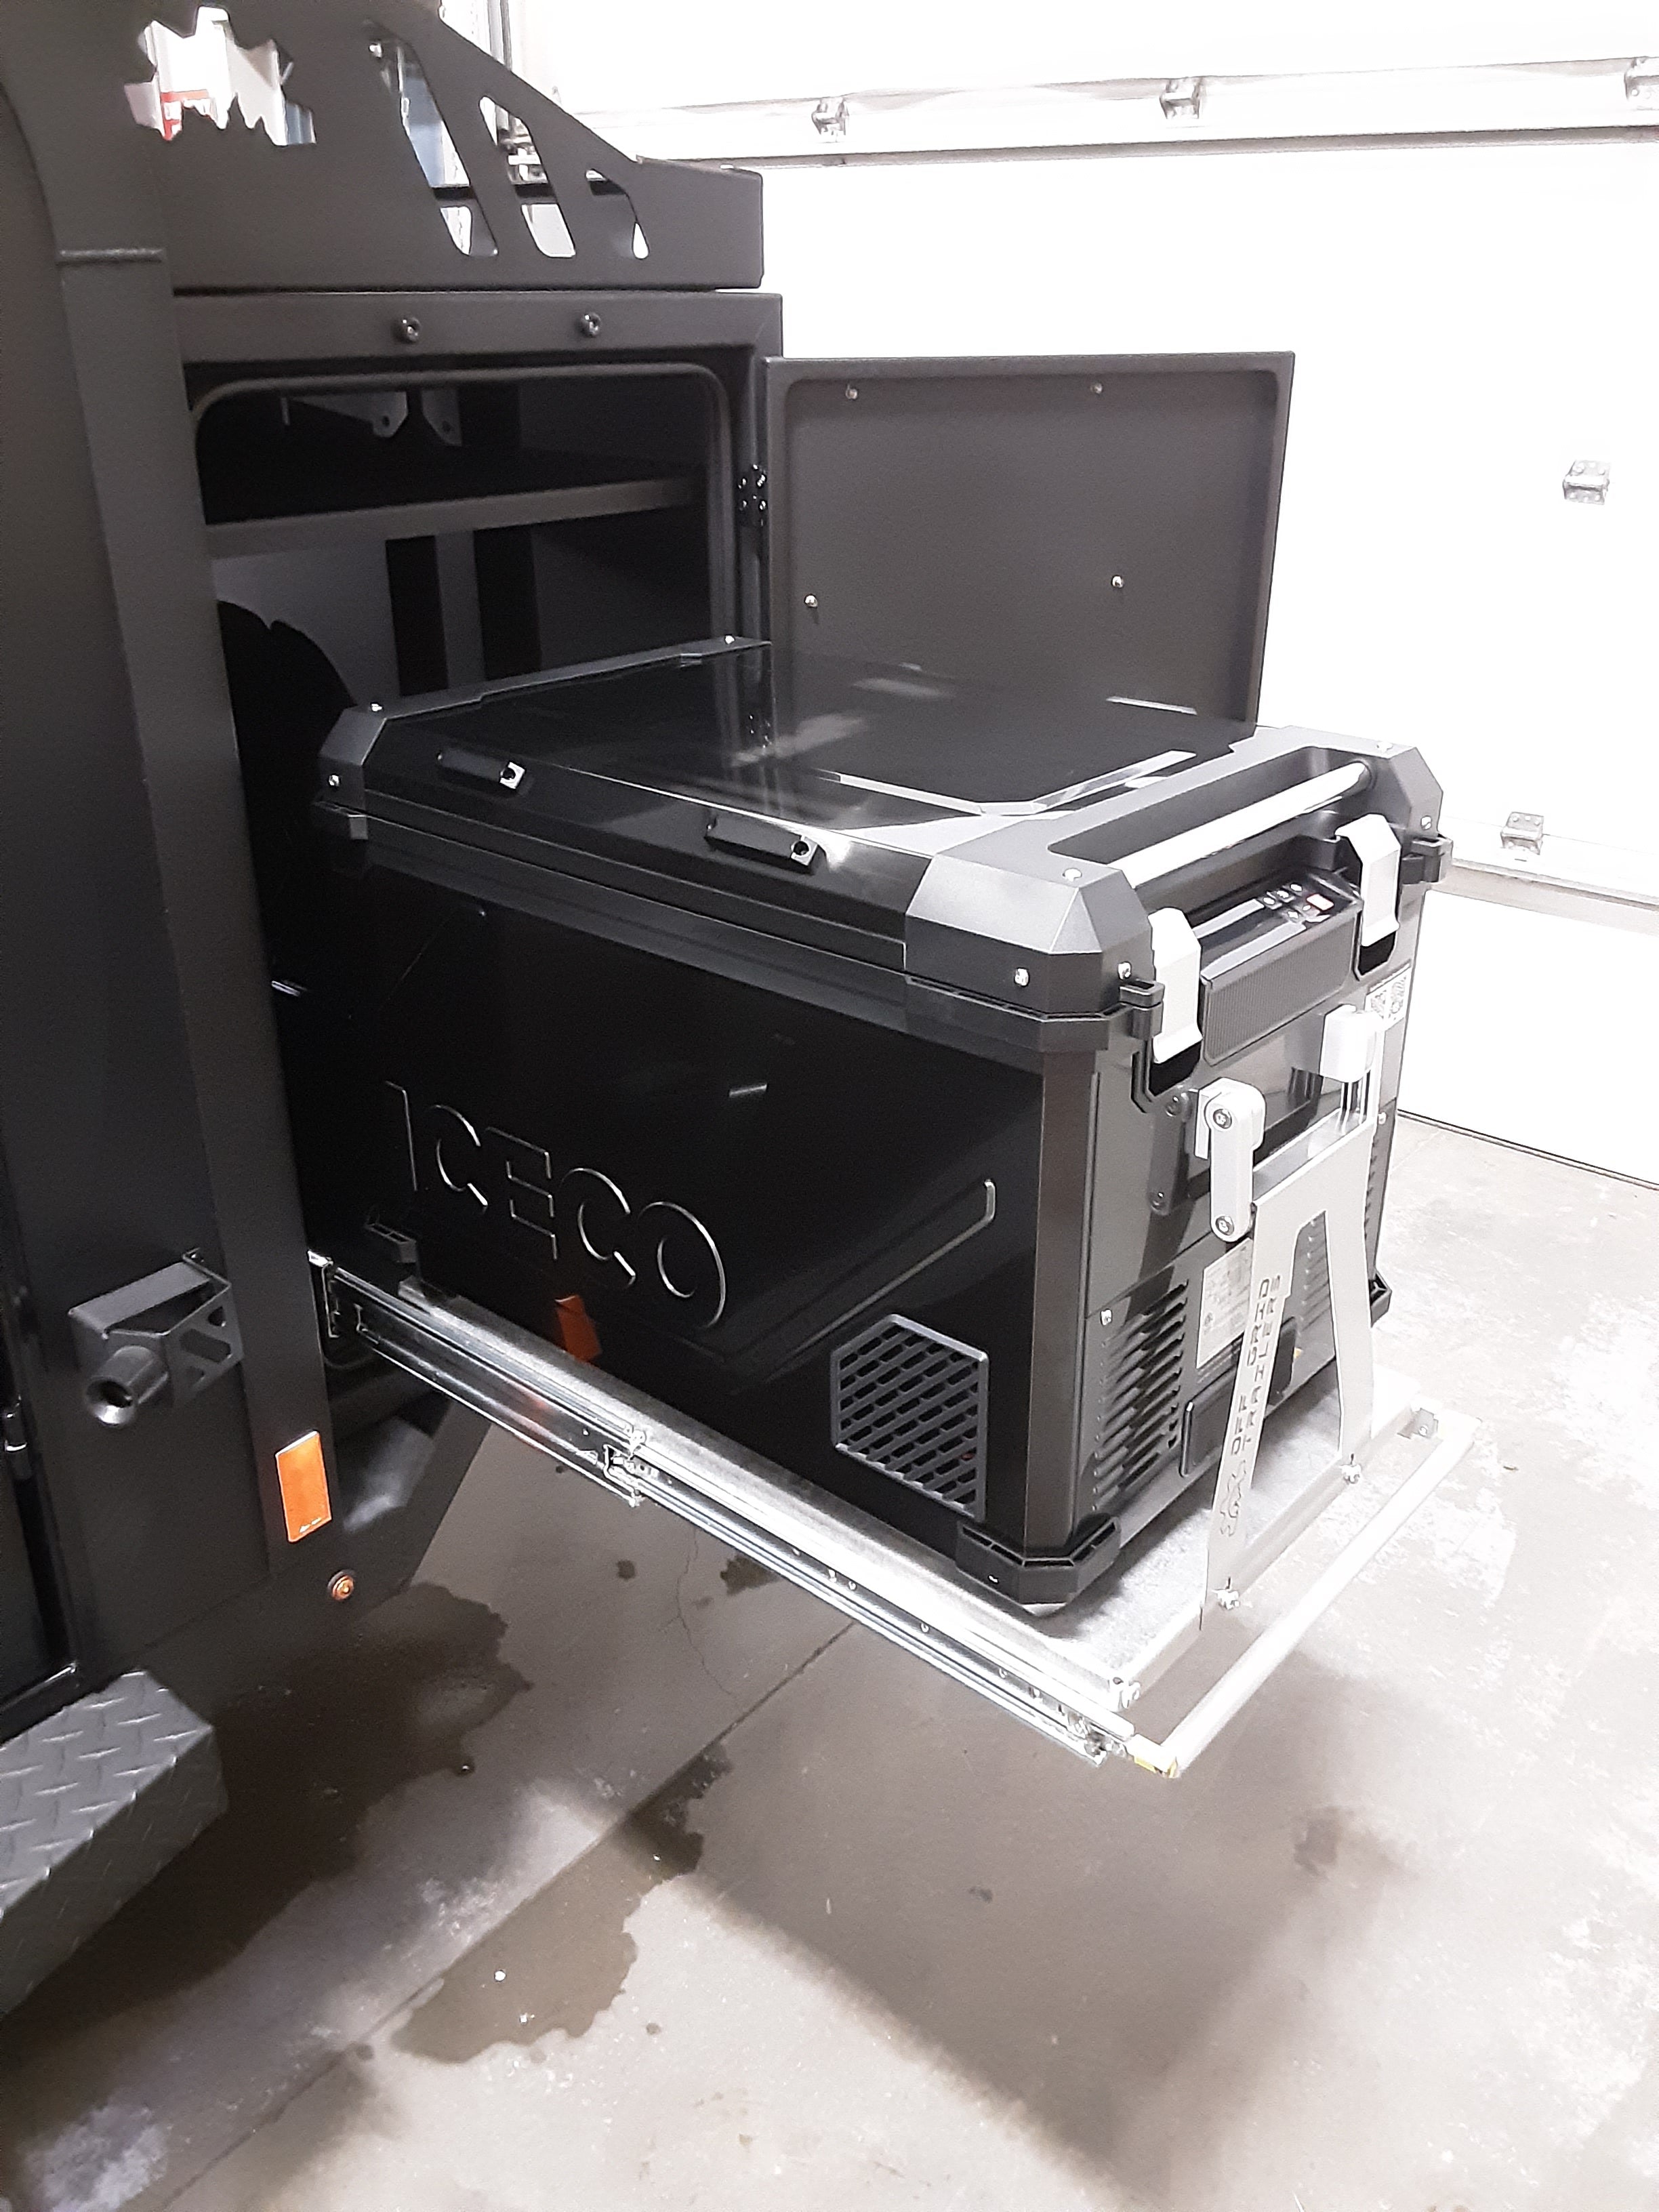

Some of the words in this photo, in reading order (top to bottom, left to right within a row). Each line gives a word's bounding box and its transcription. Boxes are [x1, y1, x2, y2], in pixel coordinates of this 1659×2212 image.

[385, 1080, 726, 1329] ICECO
[1231, 1395, 1247, 1456] OFF
[1246, 1278, 1270, 1367] GRID
[1242, 1274, 1281, 1452] TRAILERS
